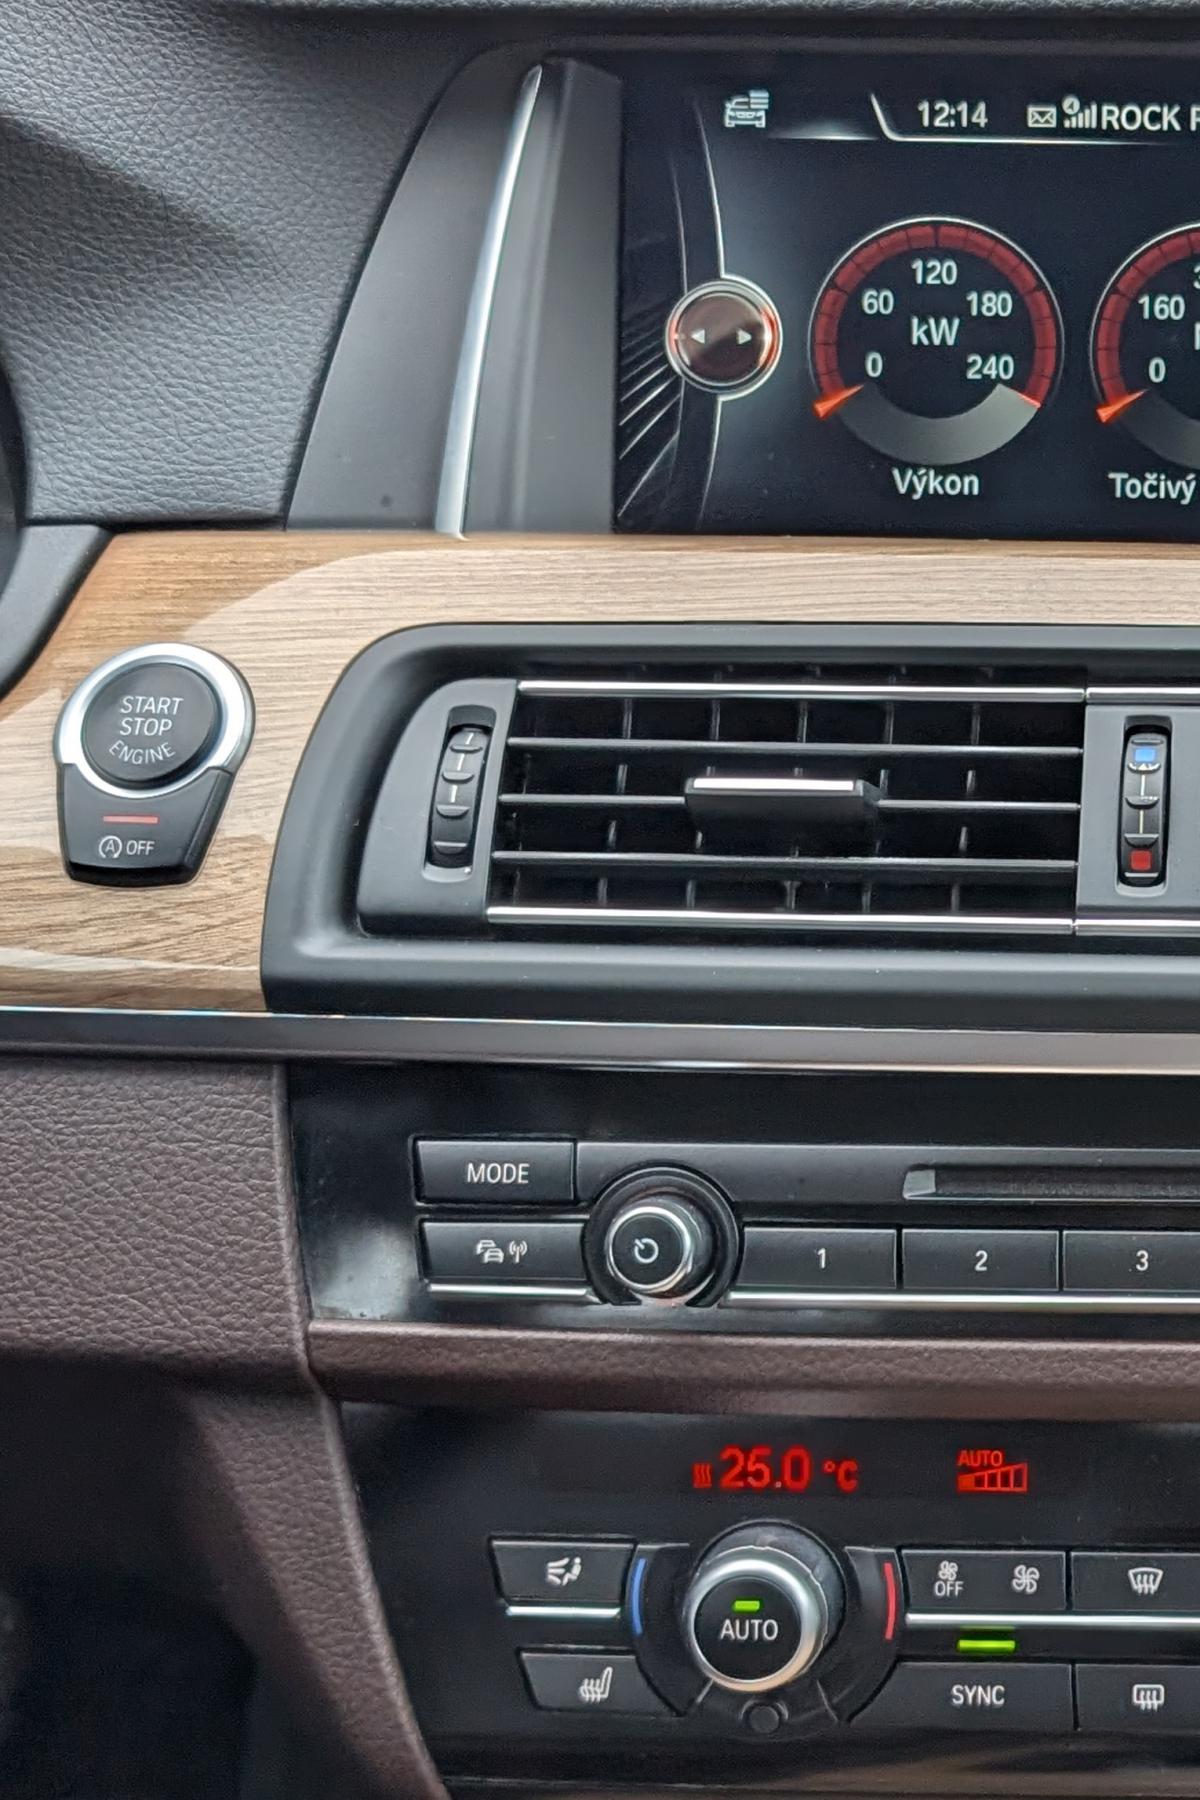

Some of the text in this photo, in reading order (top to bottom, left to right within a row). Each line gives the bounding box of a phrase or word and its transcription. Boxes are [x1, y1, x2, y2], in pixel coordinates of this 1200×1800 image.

[917, 100, 988, 128] 12:14
[1101, 104, 1181, 131] ROCK
[911, 259, 958, 285] 120
[862, 289, 894, 315] 60
[966, 291, 1013, 317] 180
[1138, 294, 1186, 321] 160
[911, 316, 960, 346] kW
[865, 351, 883, 378] 0
[966, 354, 1015, 380] 240
[1148, 357, 1166, 383] 0
[892, 468, 979, 500] Výkon
[1107, 472, 1197, 505] Točivý
[120, 695, 184, 715] START
[119, 717, 173, 736] STOP
[108, 739, 175, 765] ENGINE
[125, 839, 155, 856] OFF
[467, 1162, 530, 1184] MODE
[817, 1247, 826, 1269] 1
[975, 1249, 988, 1272] 2
[1135, 1249, 1149, 1271] 3
[720, 1445, 811, 1491] 25.0
[957, 1449, 1004, 1467] AUTO
[934, 1581, 964, 1597] OFF
[720, 1618, 779, 1641] AUTO
[951, 1684, 1005, 1706] SYNC
